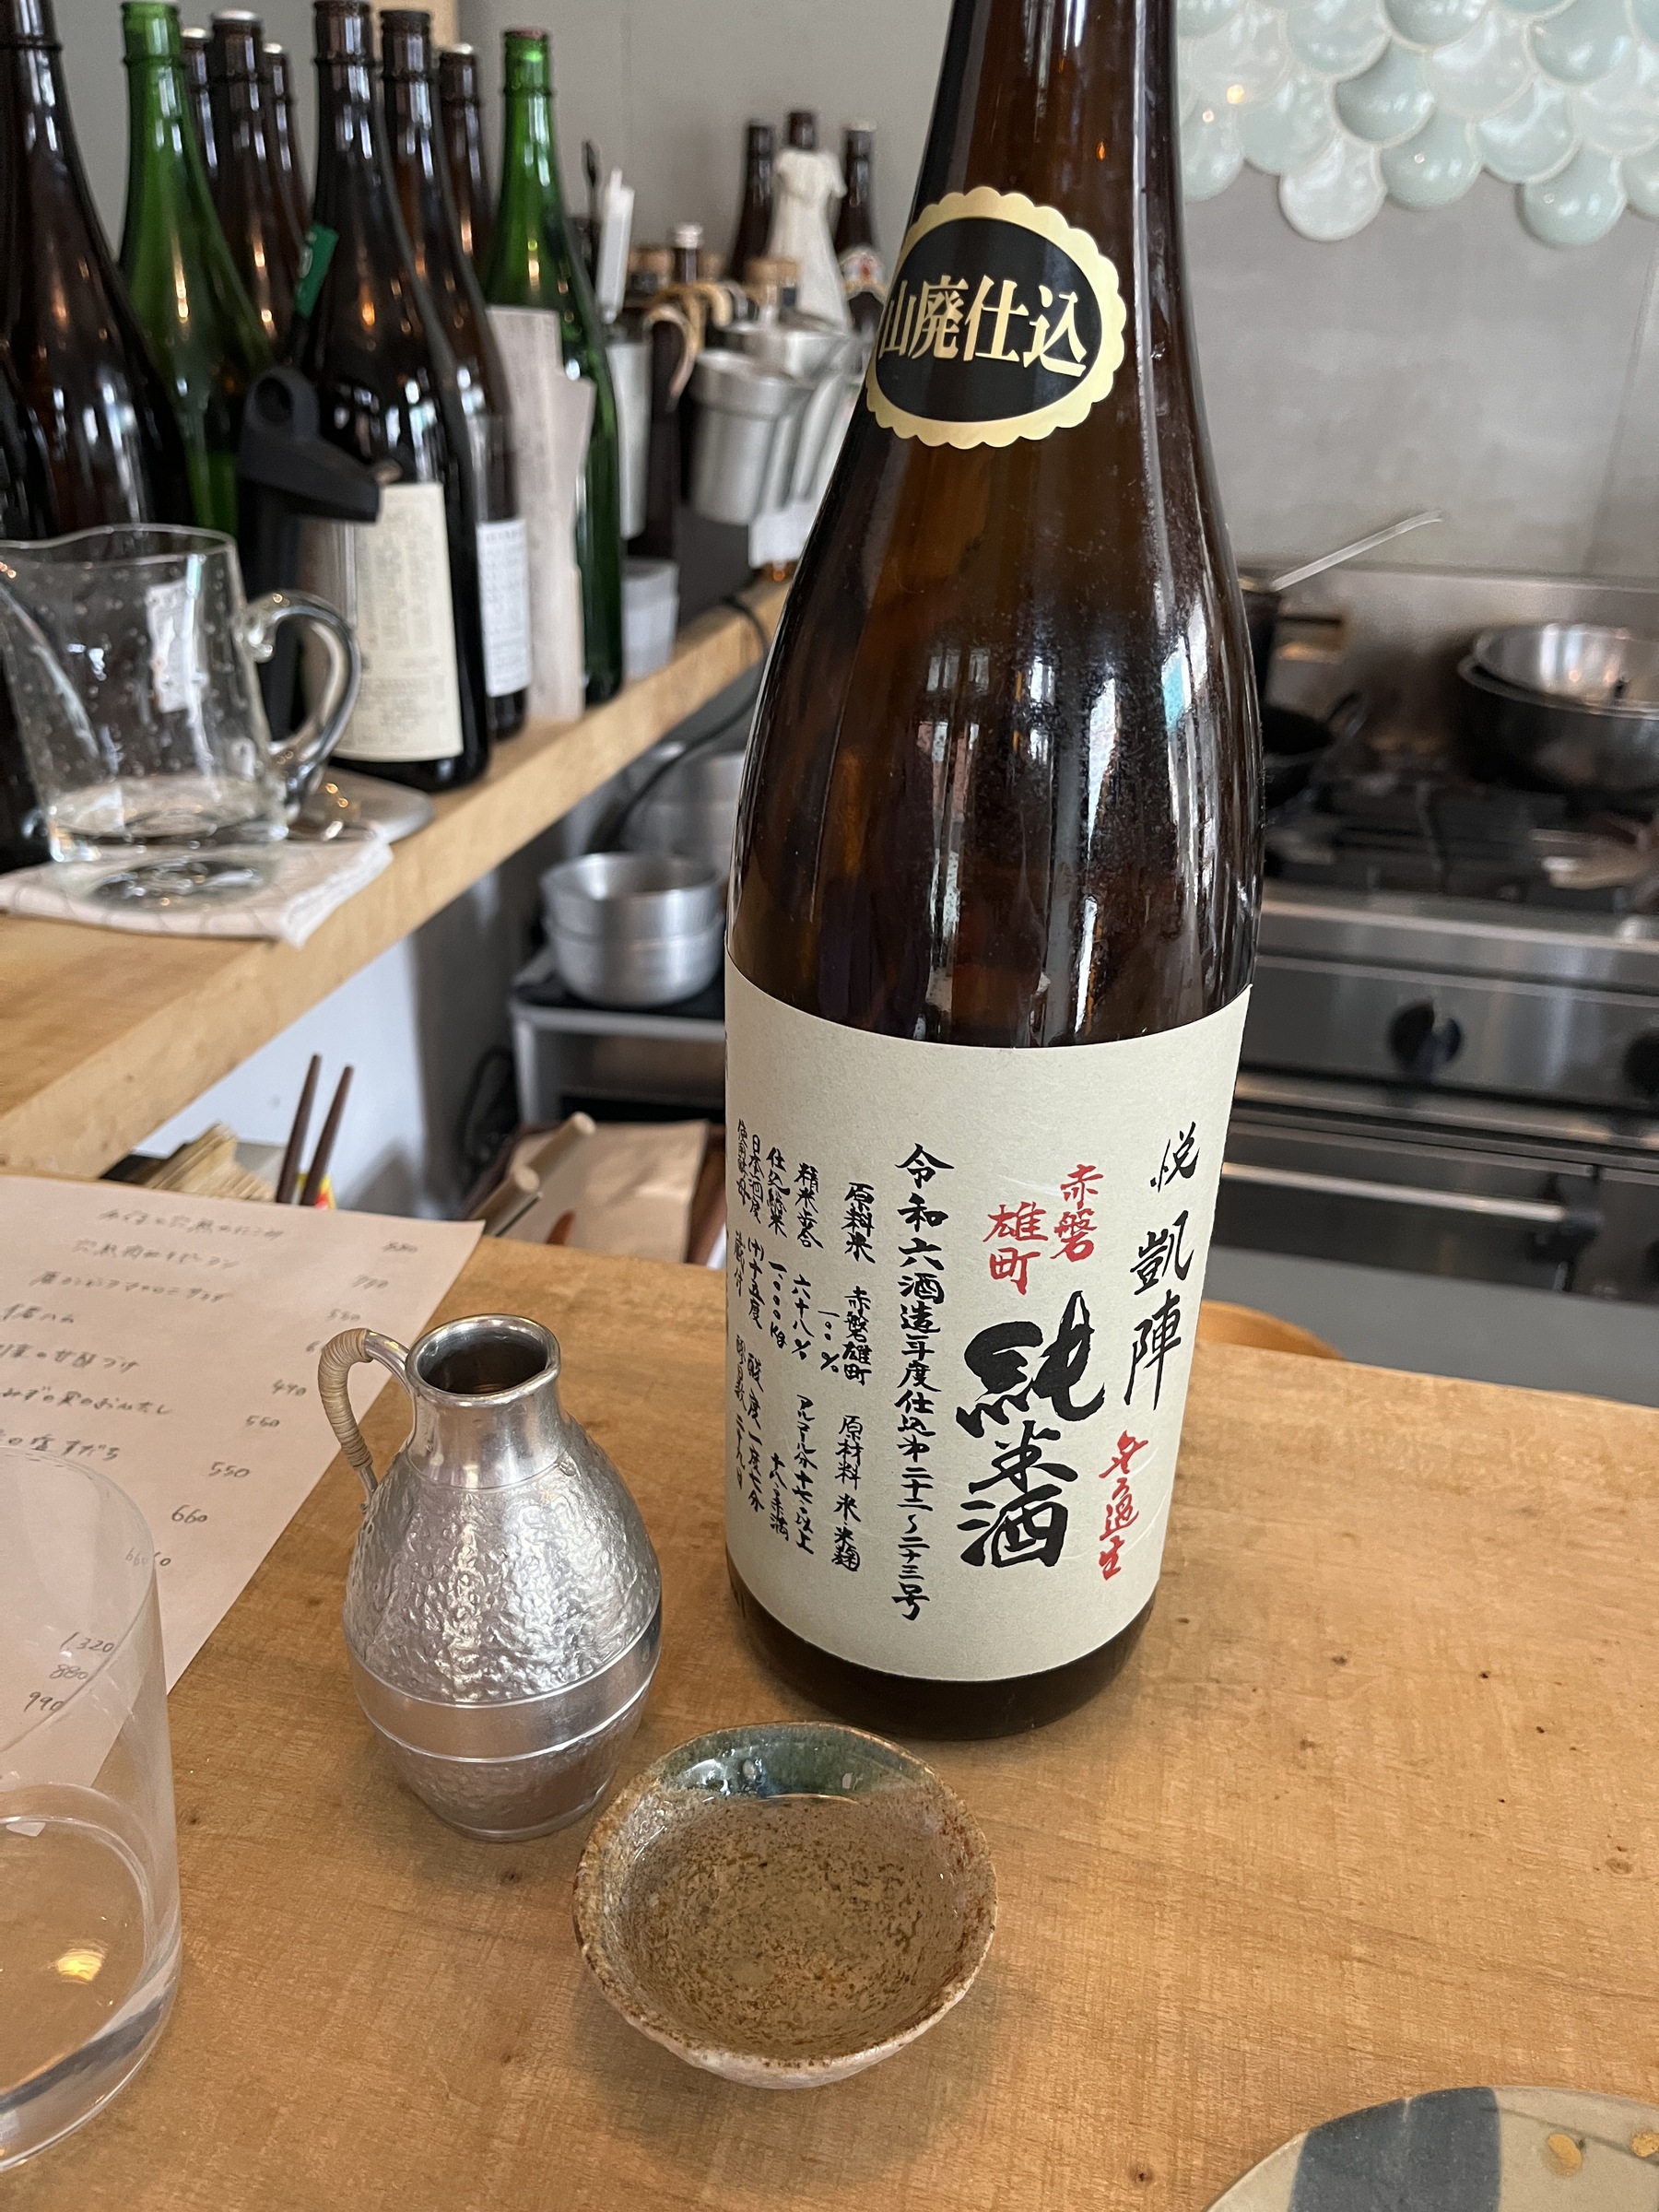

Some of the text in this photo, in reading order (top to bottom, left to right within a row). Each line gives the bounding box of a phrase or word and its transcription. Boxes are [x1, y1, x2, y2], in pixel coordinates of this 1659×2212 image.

[878, 274, 1087, 377] 山廃仕込
[794, 1162, 824, 1249] 精米歩合
[841, 1182, 876, 1264] 原料米
[1051, 1165, 1103, 1262] 赤磐
[983, 1202, 1048, 1295] 雄町
[841, 1286, 872, 1386] 赤磐雄町
[208, 1461, 251, 1478] 550
[835, 1415, 864, 1490] 原材料
[955, 1290, 1105, 1568] 純米酒
[171, 1504, 208, 1524] 660
[49, 1664, 89, 1680] 880
[60, 1630, 115, 1653] 1320
[24, 1690, 65, 1712] 990
